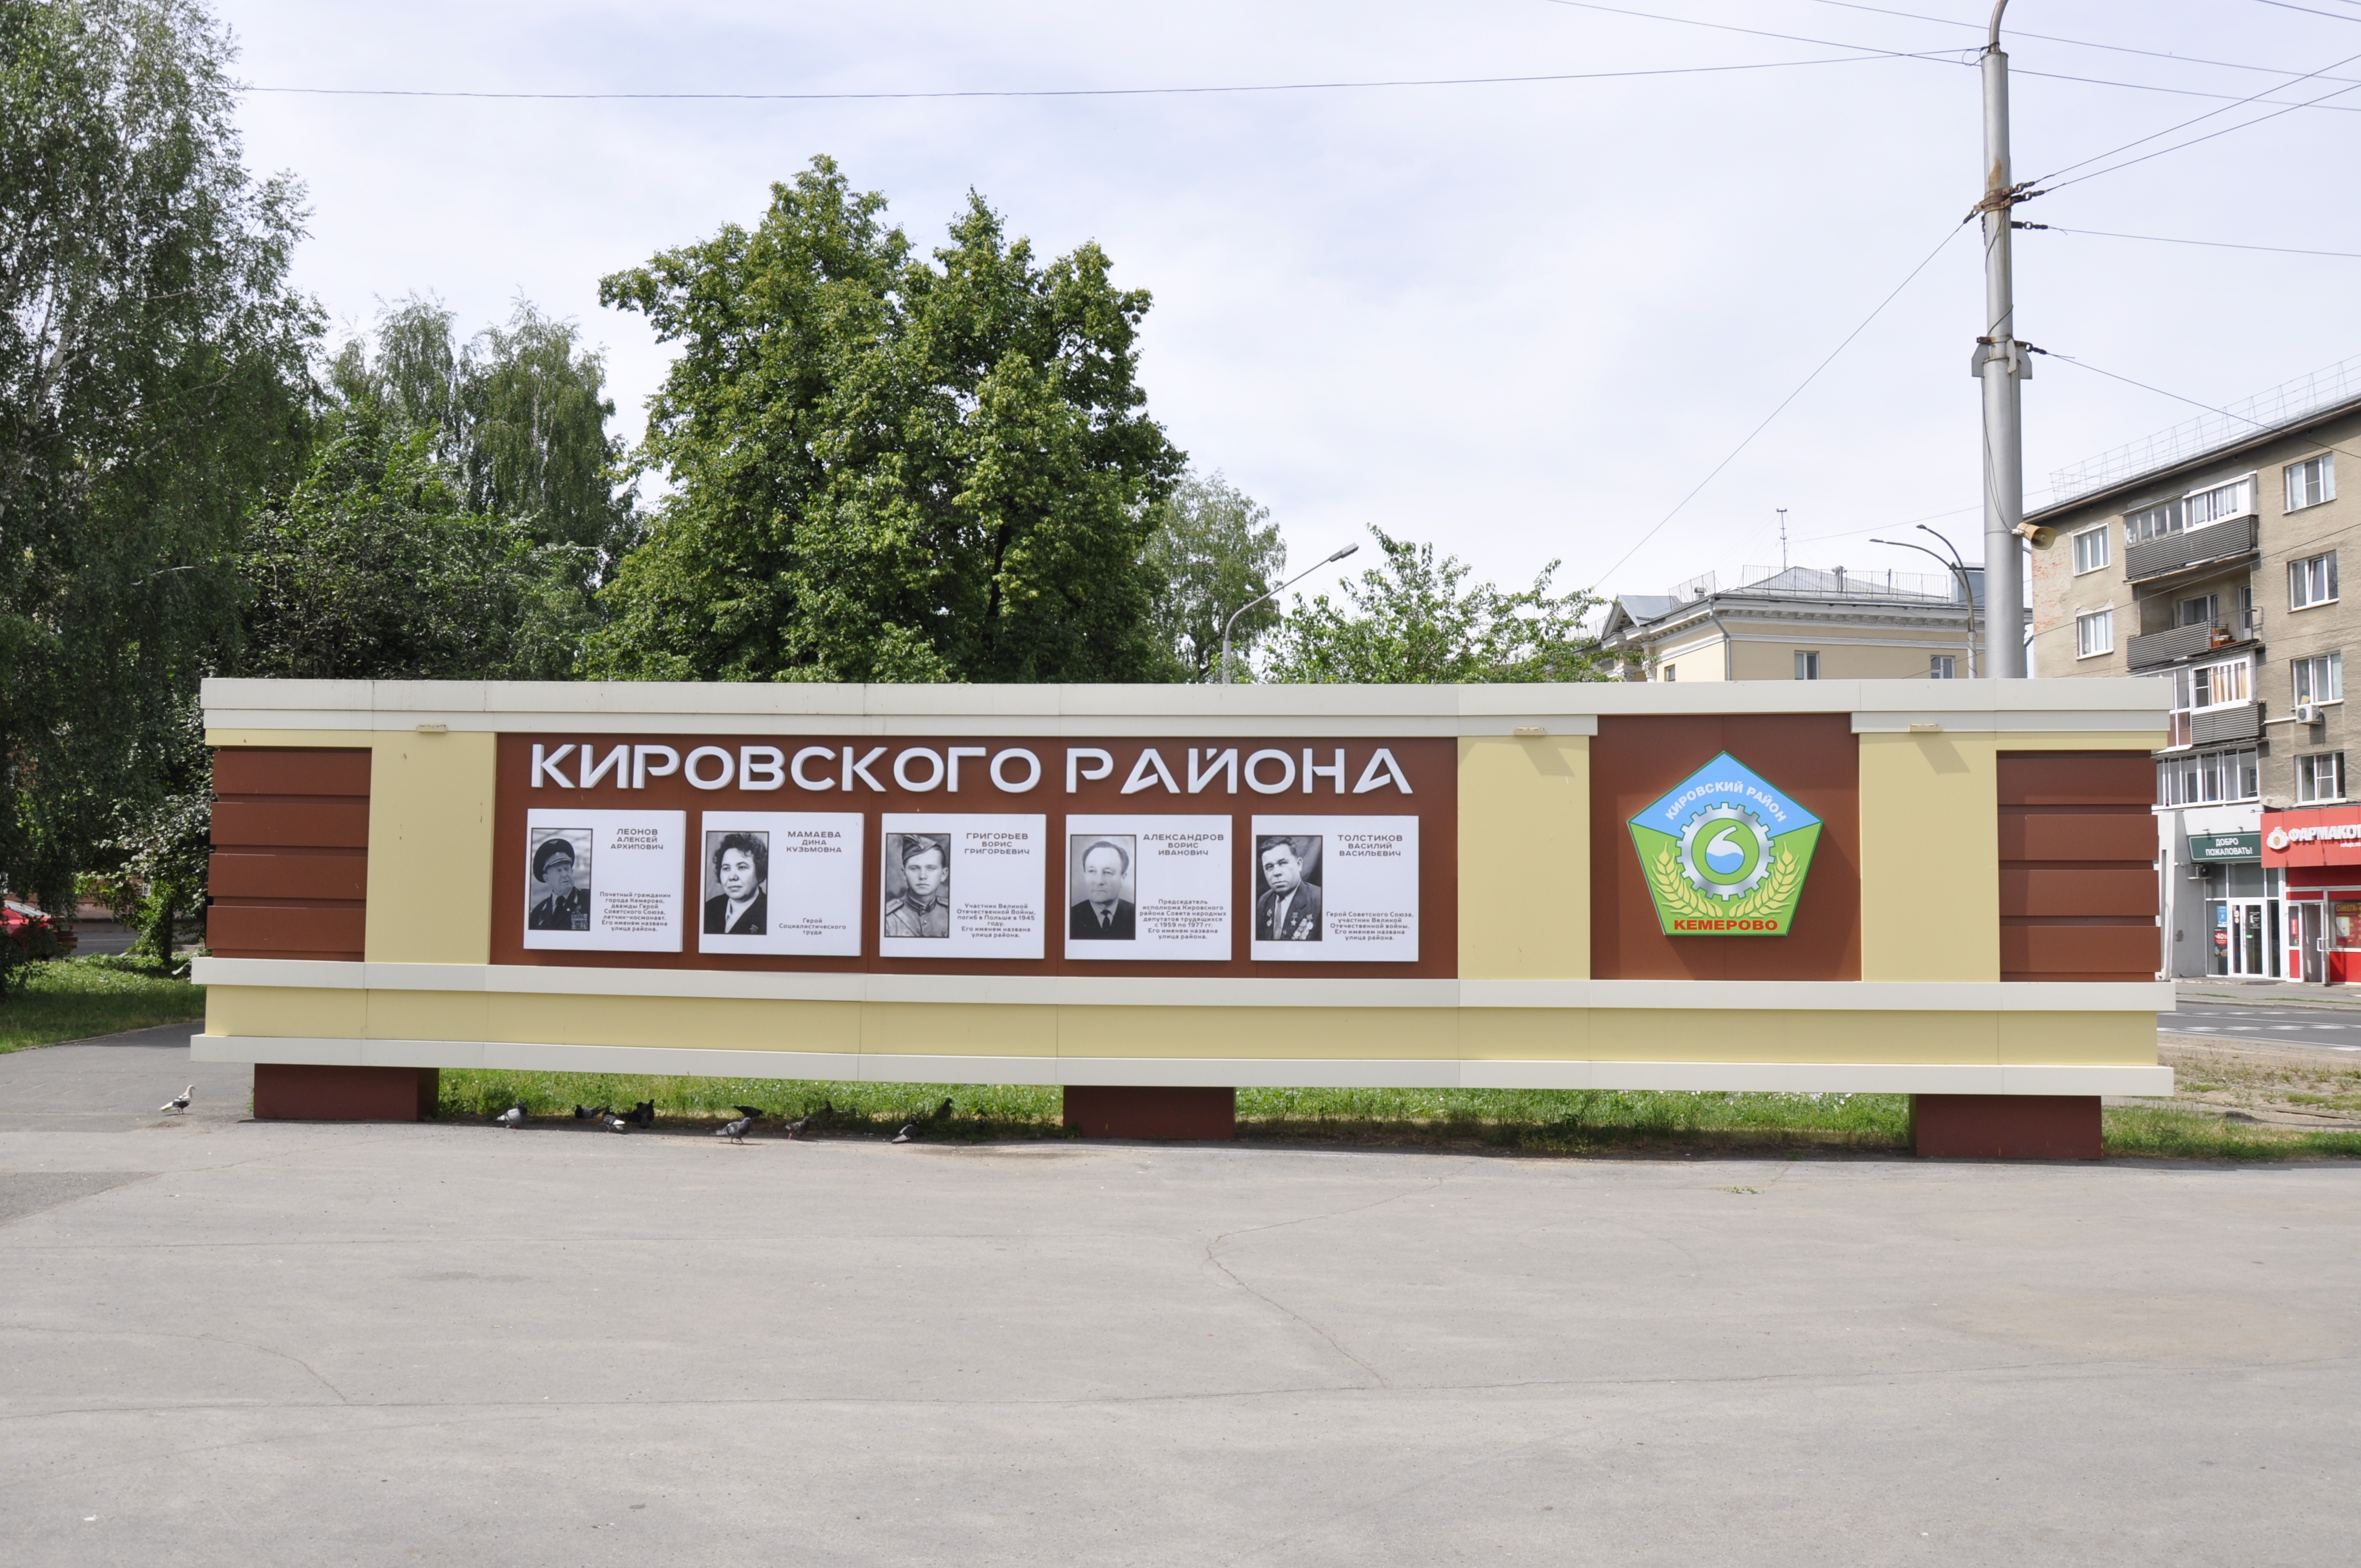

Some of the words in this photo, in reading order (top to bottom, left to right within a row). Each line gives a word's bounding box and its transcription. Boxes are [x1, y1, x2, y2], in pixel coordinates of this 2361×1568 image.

[531, 743, 1041, 793] КИРОВСКОГО
[1065, 747, 1413, 794] РАЙОНА
[1665, 781, 1744, 820] КИРОВСКИЙ
[1745, 786, 1787, 823] РАЙОН
[2215, 837, 2239, 846] ДОБРО
[2205, 847, 2253, 856] ПОЖАЛОВАТЬ!
[1674, 919, 1778, 930] КЕМЕРОВО
